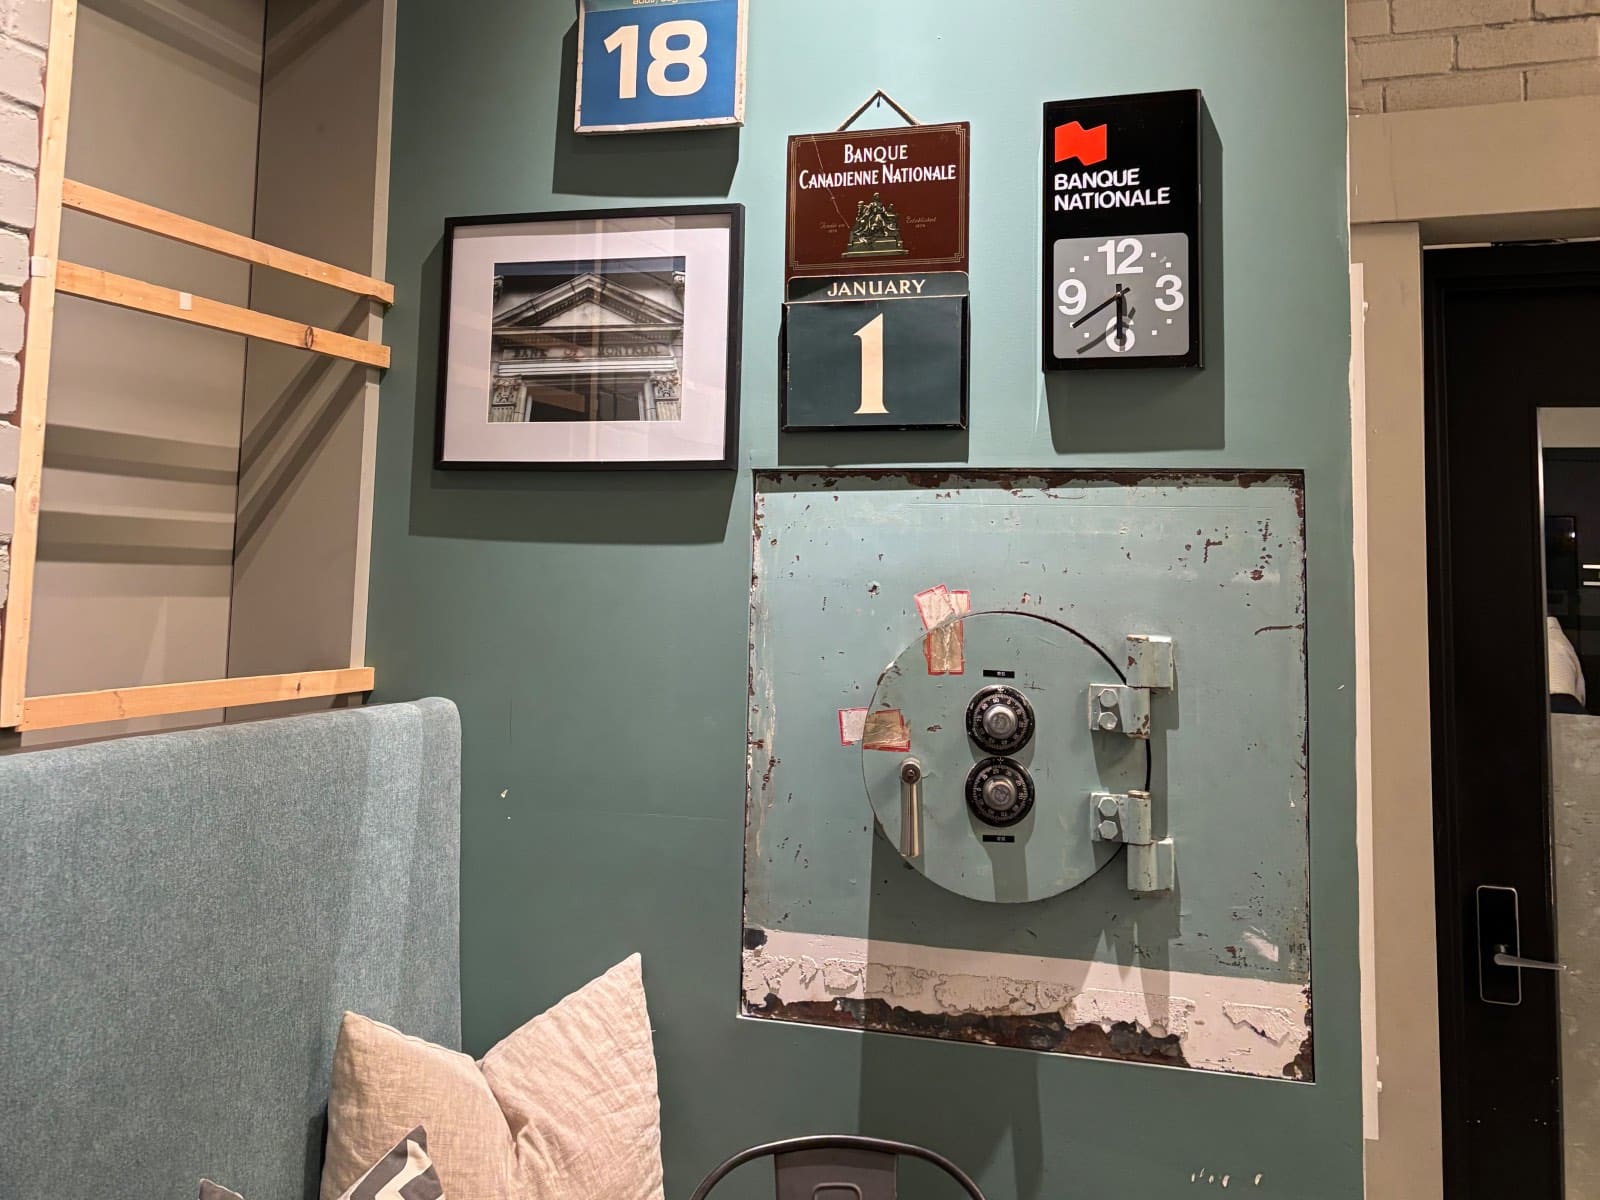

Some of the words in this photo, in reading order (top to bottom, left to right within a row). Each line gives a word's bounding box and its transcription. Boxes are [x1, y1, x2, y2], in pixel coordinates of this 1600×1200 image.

[603, 19, 708, 100] 18
[844, 143, 909, 164] BANQUE
[799, 169, 879, 190] CANADIENNE
[882, 163, 956, 184] NATIONALE
[1054, 168, 1140, 191] BANQUE
[1054, 187, 1171, 211] NATIONALE
[1097, 238, 1144, 275] 12
[827, 279, 926, 297] JANUARY
[1057, 278, 1087, 316] 9
[1154, 274, 1184, 312] 3
[1105, 314, 1136, 353] 6
[853, 312, 890, 414] 1
